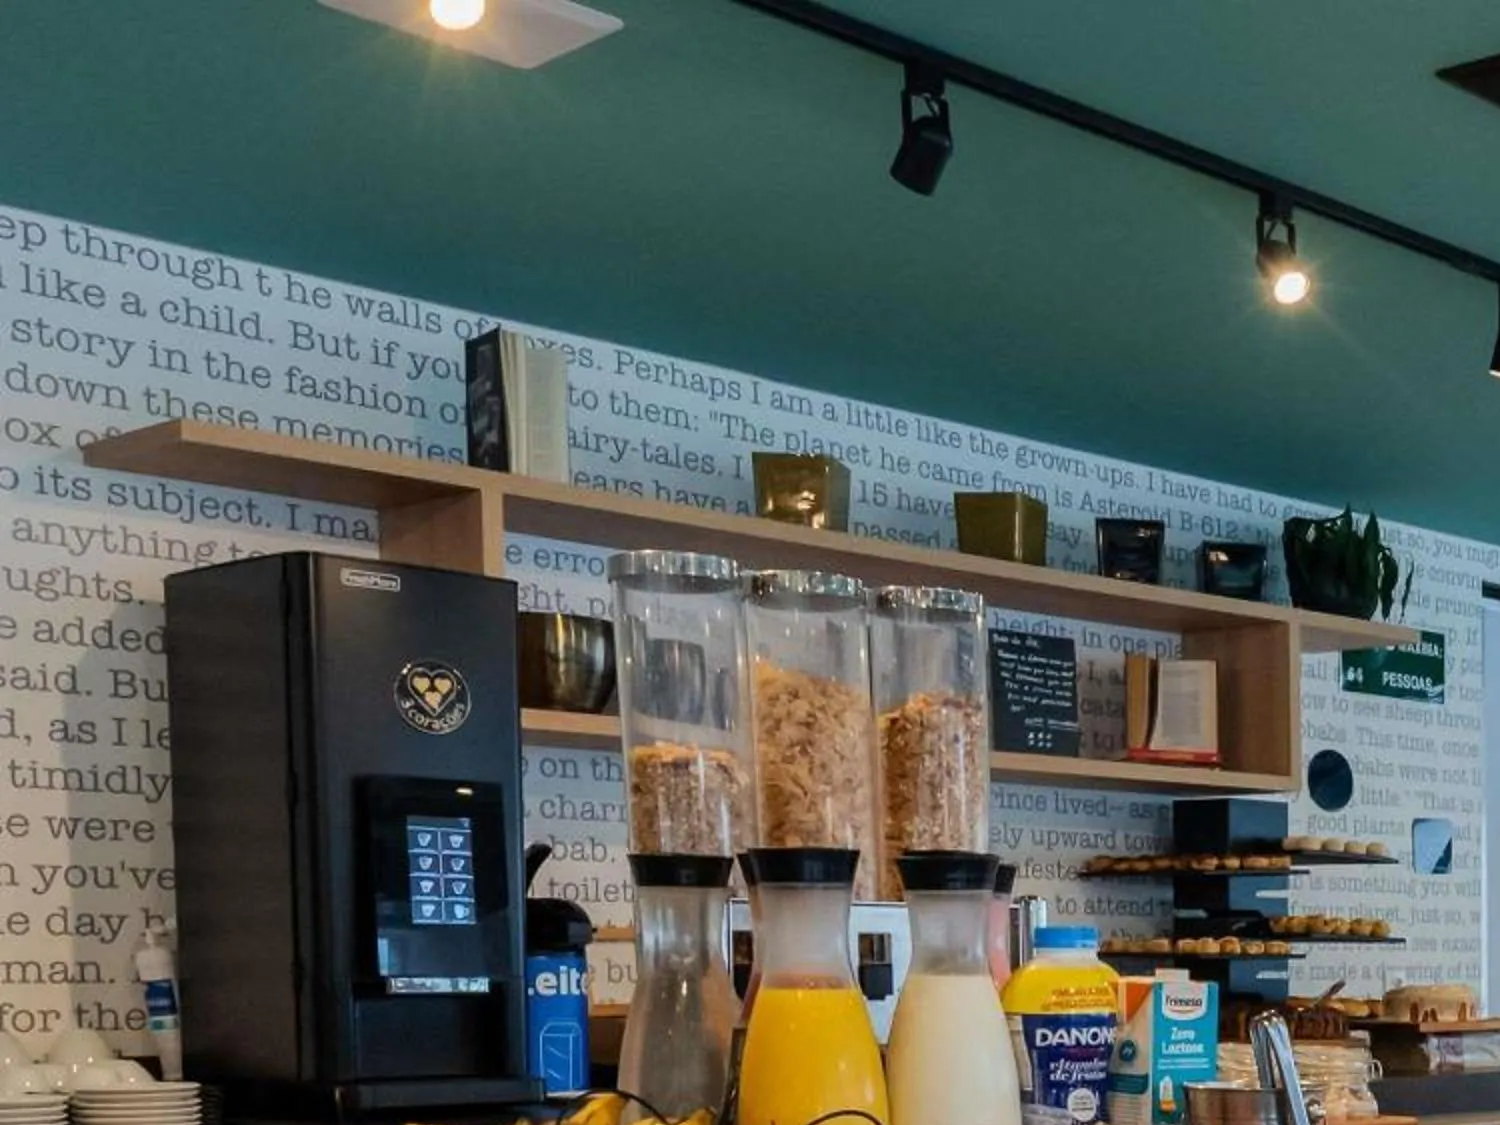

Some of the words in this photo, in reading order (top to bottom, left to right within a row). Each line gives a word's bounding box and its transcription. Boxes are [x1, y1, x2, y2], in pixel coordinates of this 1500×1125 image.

[20, 264, 107, 309] like
[120, 291, 147, 317] a
[160, 298, 275, 344] child.
[288, 320, 360, 362] But
[370, 338, 399, 366] if
[569, 385, 598, 410] to
[610, 391, 699, 432] them:
[709, 410, 775, 446] "The
[784, 429, 871, 468] planet
[881, 447, 910, 474] he
[919, 459, 983, 489] came
[991, 473, 1048, 502] from
[1053, 487, 1073, 510] is
[1081, 491, 1172, 526] Asteroid
[62, 223, 242, 290] through
[344, 293, 443, 336] walls
[614, 350, 741, 402] Perhaps
[751, 380, 762, 405] I
[770, 391, 813, 416] am
[821, 402, 839, 420] a
[846, 402, 909, 437] little
[916, 418, 962, 449] like
[969, 431, 1010, 459] the
[1016, 443, 1139, 490] grown-ups.
[1161, 480, 1211, 504] have
[1217, 491, 1252, 513] had
[1257, 502, 1278, 519] to
[4, 361, 129, 411] down
[142, 385, 259, 428] these
[272, 411, 465, 465] memories
[571, 470, 643, 498] ears
[4, 417, 63, 450] ox
[10, 317, 135, 368] story
[148, 342, 192, 374] in
[205, 350, 272, 388] the
[284, 367, 438, 420] fashion
[568, 428, 722, 477] airy-tales.
[859, 481, 888, 504] 15
[897, 488, 955, 519] have
[12, 516, 217, 565] anything
[34, 465, 92, 499] its
[107, 478, 272, 528] subject.
[285, 503, 299, 530] I
[1082, 627, 1105, 649] in
[1109, 633, 1147, 654] one
[6, 568, 144, 606] ughts.
[33, 618, 168, 655] added
[1382, 672, 1433, 690] PESSOAS
[49, 719, 98, 743] as
[112, 718, 129, 746] I
[539, 757, 581, 779] on
[8, 761, 173, 803] timidly
[1030, 825, 1116, 851] upward
[46, 816, 155, 842] were
[32, 858, 177, 895] you've
[1056, 899, 1077, 916] to
[1083, 899, 1154, 917] attend
[46, 909, 127, 943] day
[0, 1005, 61, 1033] for
[75, 1005, 146, 1033] the
[1035, 1027, 1117, 1047] DANON
